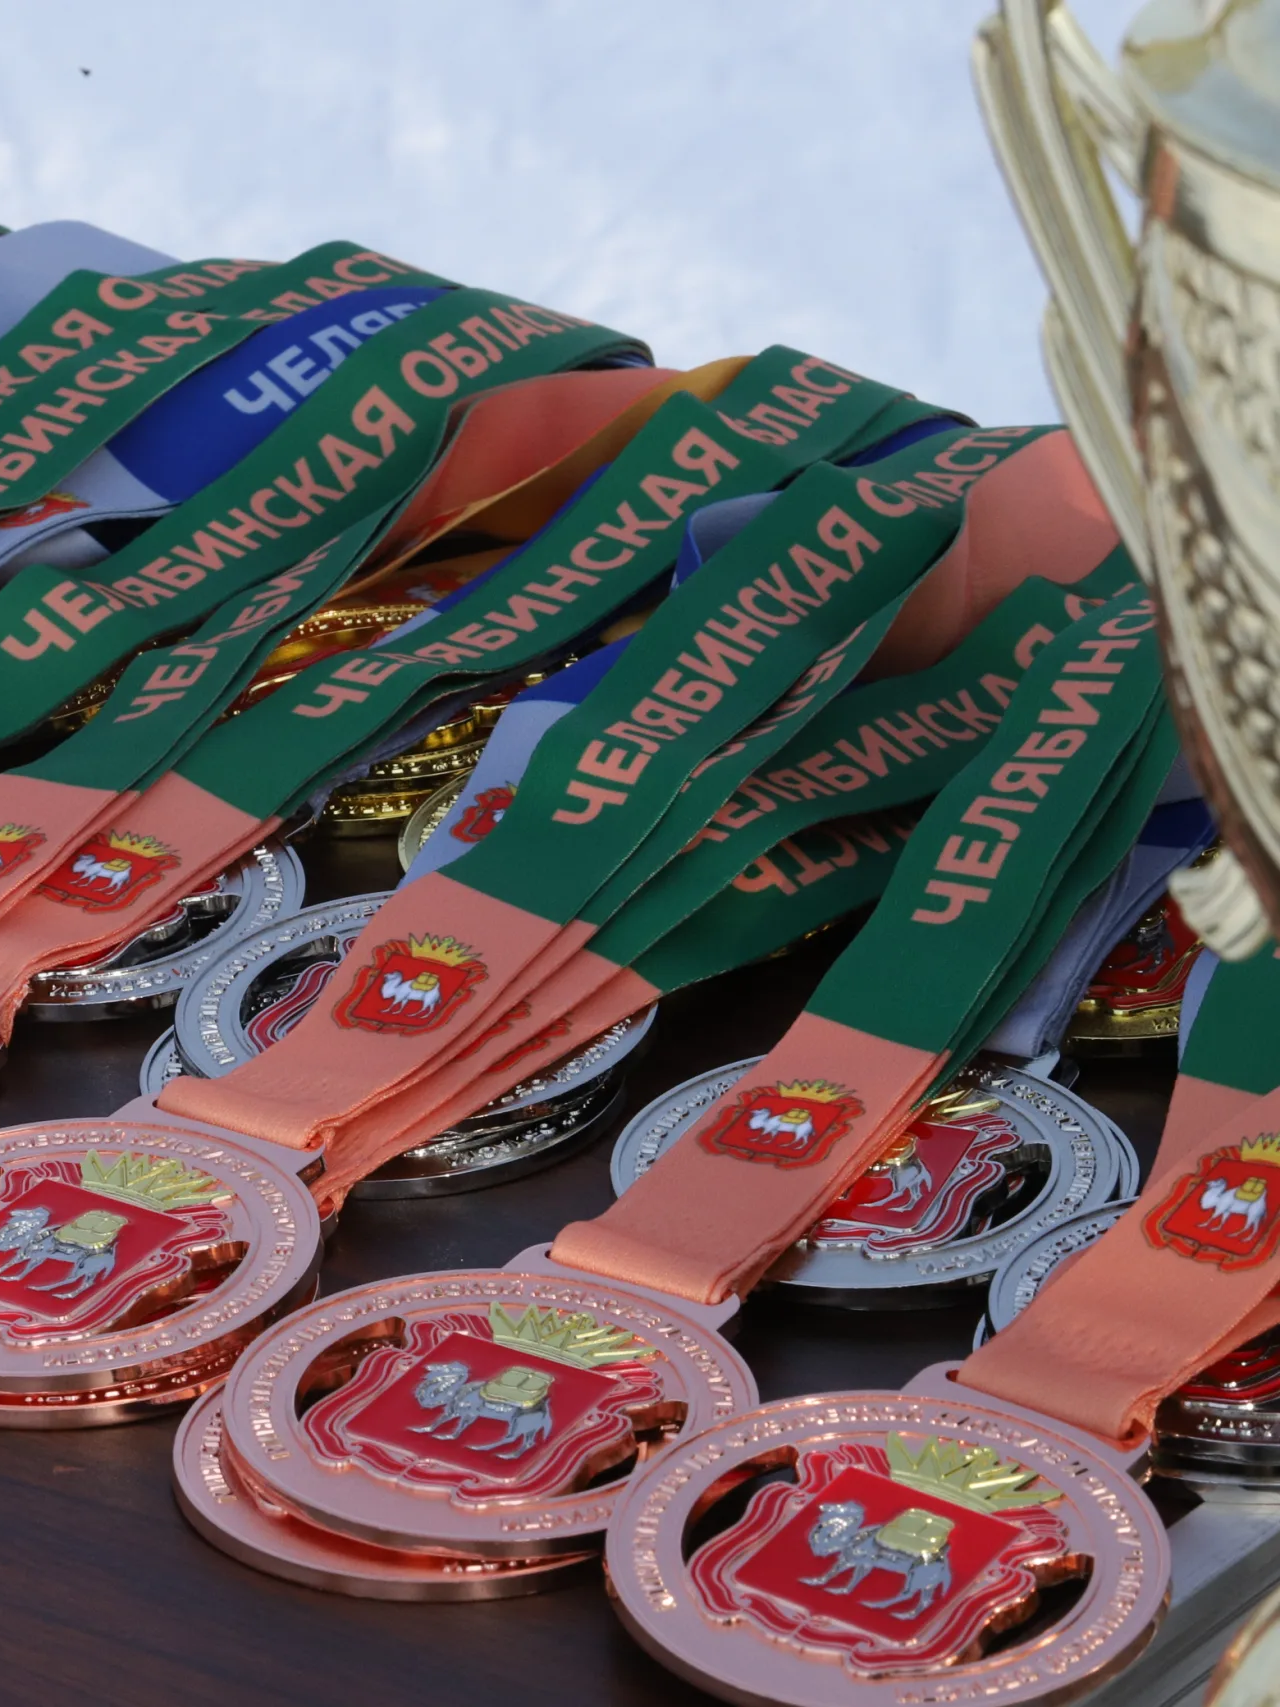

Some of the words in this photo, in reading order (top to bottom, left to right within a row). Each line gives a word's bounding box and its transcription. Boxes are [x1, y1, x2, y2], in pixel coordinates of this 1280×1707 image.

[1, 385, 416, 660] ЧЕЛЯБИНСКАЯ
[293, 427, 741, 718] ЧЕЛЯБИНСКАЯ
[552, 506, 882, 826] ЧЕЛЯБИНСКАЯ
